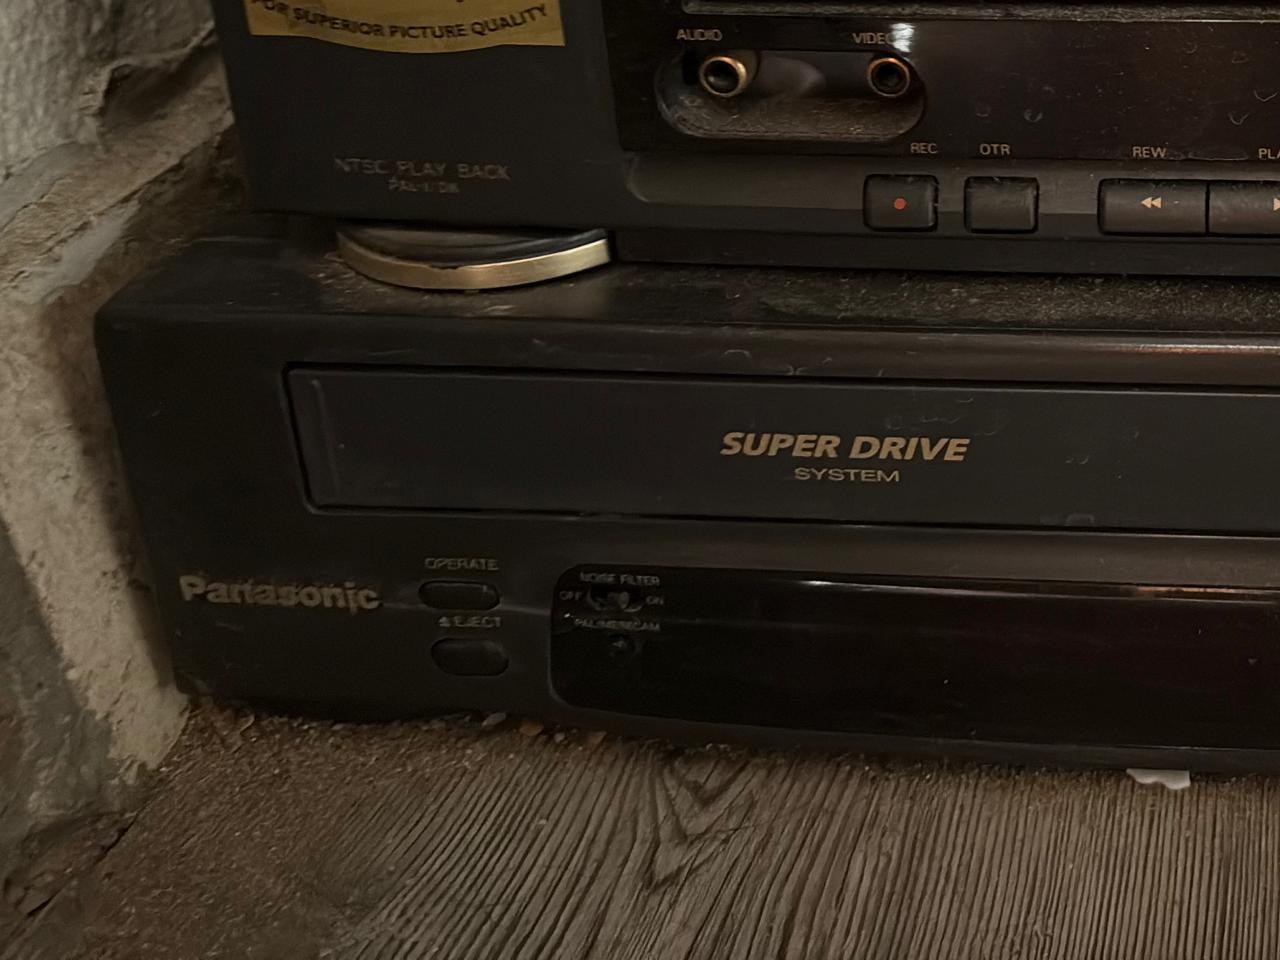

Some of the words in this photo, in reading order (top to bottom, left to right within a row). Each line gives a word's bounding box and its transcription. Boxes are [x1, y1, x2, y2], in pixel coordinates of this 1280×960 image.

[293, 6, 385, 36] SUPERIOR
[389, 22, 468, 39] PICTURE
[470, 3, 547, 35] QUALITY
[676, 28, 723, 41] AUDIO
[909, 143, 938, 155] REC
[979, 143, 1011, 156] OTR
[1132, 146, 1168, 159] REW
[396, 159, 447, 177] PLAY
[455, 162, 512, 181] BACK
[719, 431, 841, 458] SUPER
[848, 435, 972, 461] DRIVE
[793, 466, 900, 483] SYSTEM
[424, 558, 499, 571] OPERATE
[178, 574, 383, 614] Panasonic
[454, 617, 501, 629] EJECT
